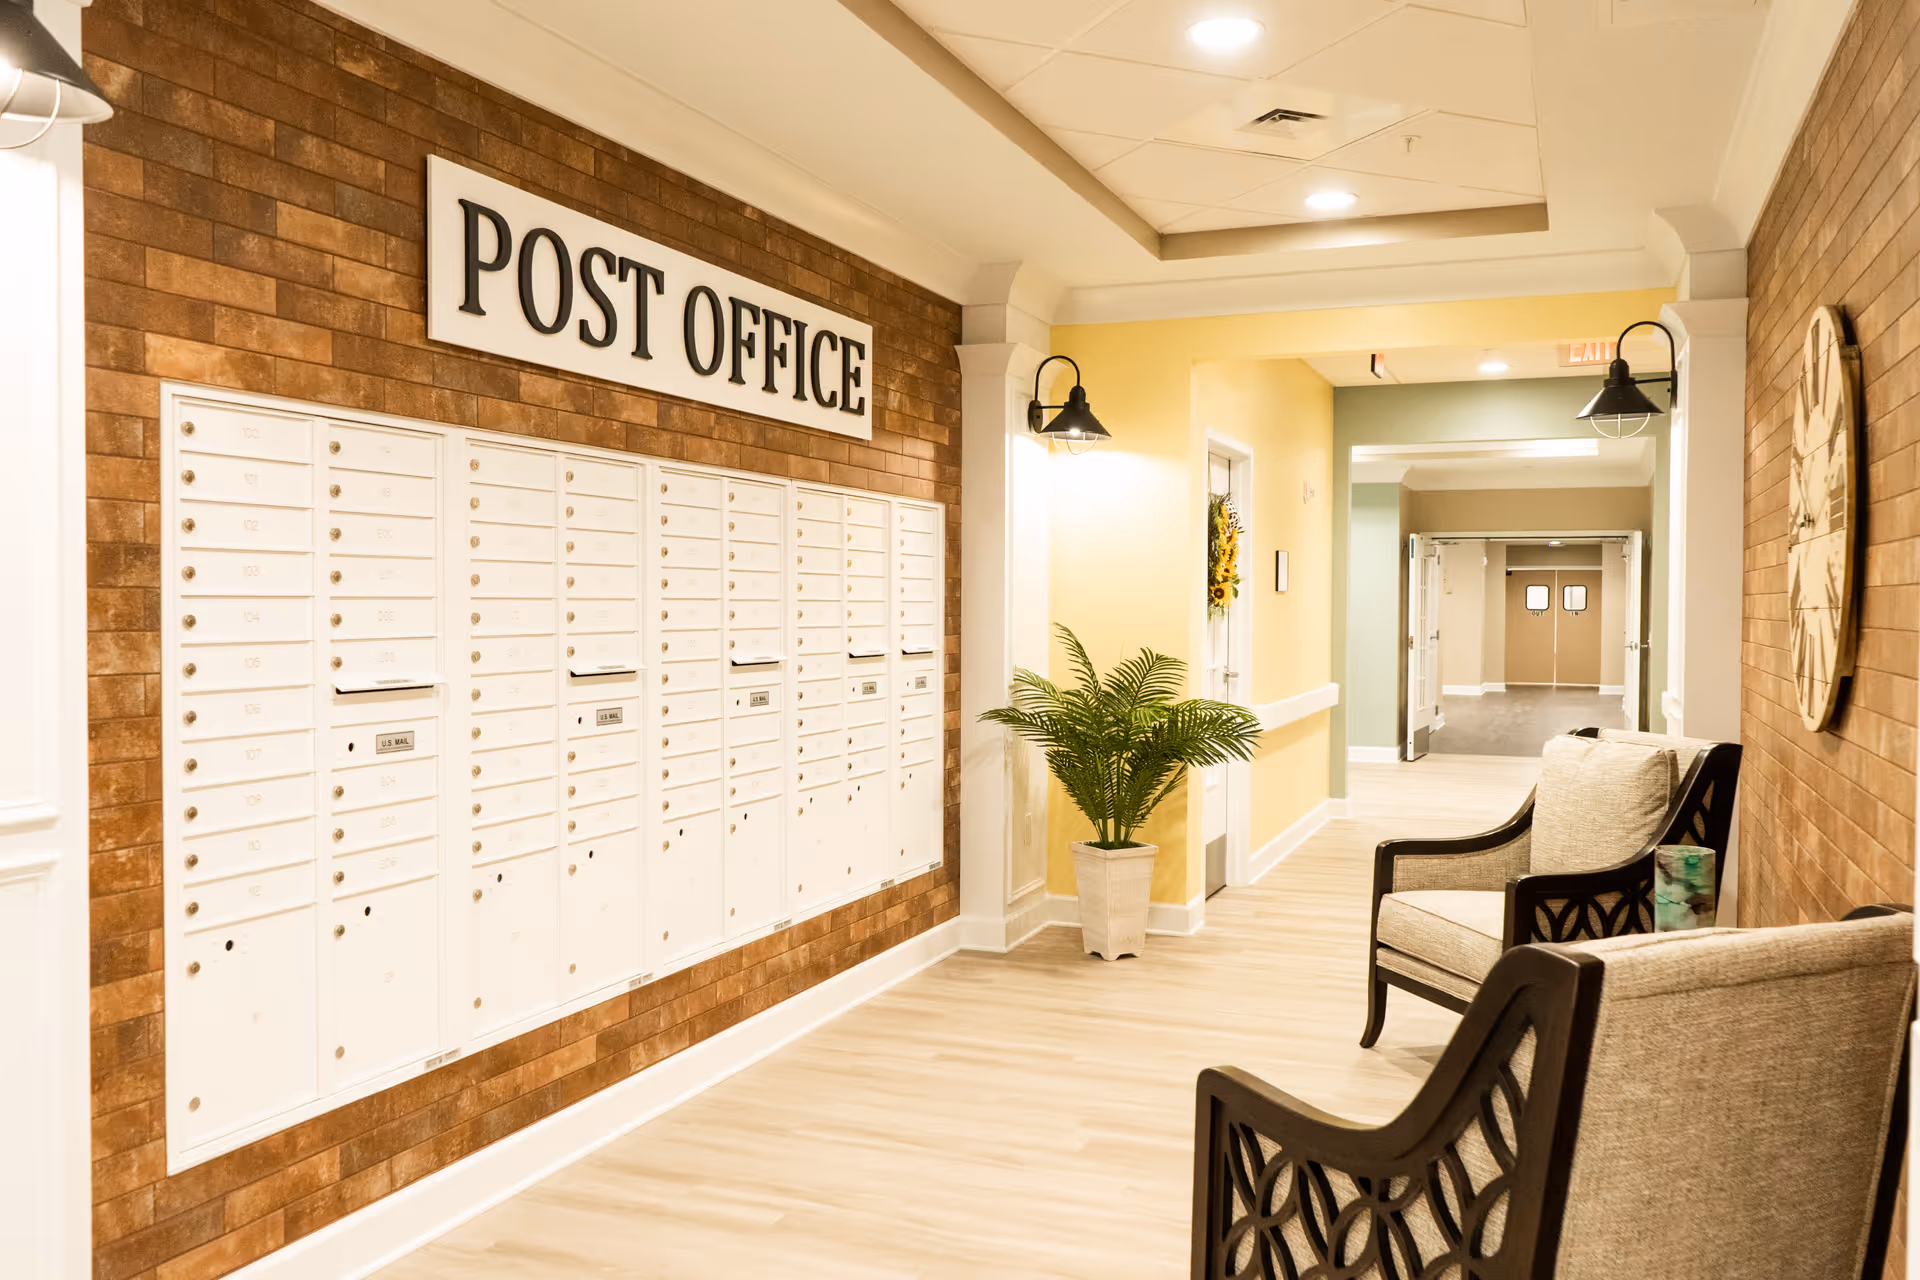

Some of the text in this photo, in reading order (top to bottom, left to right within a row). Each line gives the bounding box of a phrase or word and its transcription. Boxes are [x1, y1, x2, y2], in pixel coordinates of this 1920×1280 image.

[458, 199, 866, 416] POST OFFICE
[1569, 342, 1617, 362] EXIT
[243, 519, 260, 531] 102
[243, 611, 260, 623] 104
[244, 748, 262, 761] 107
